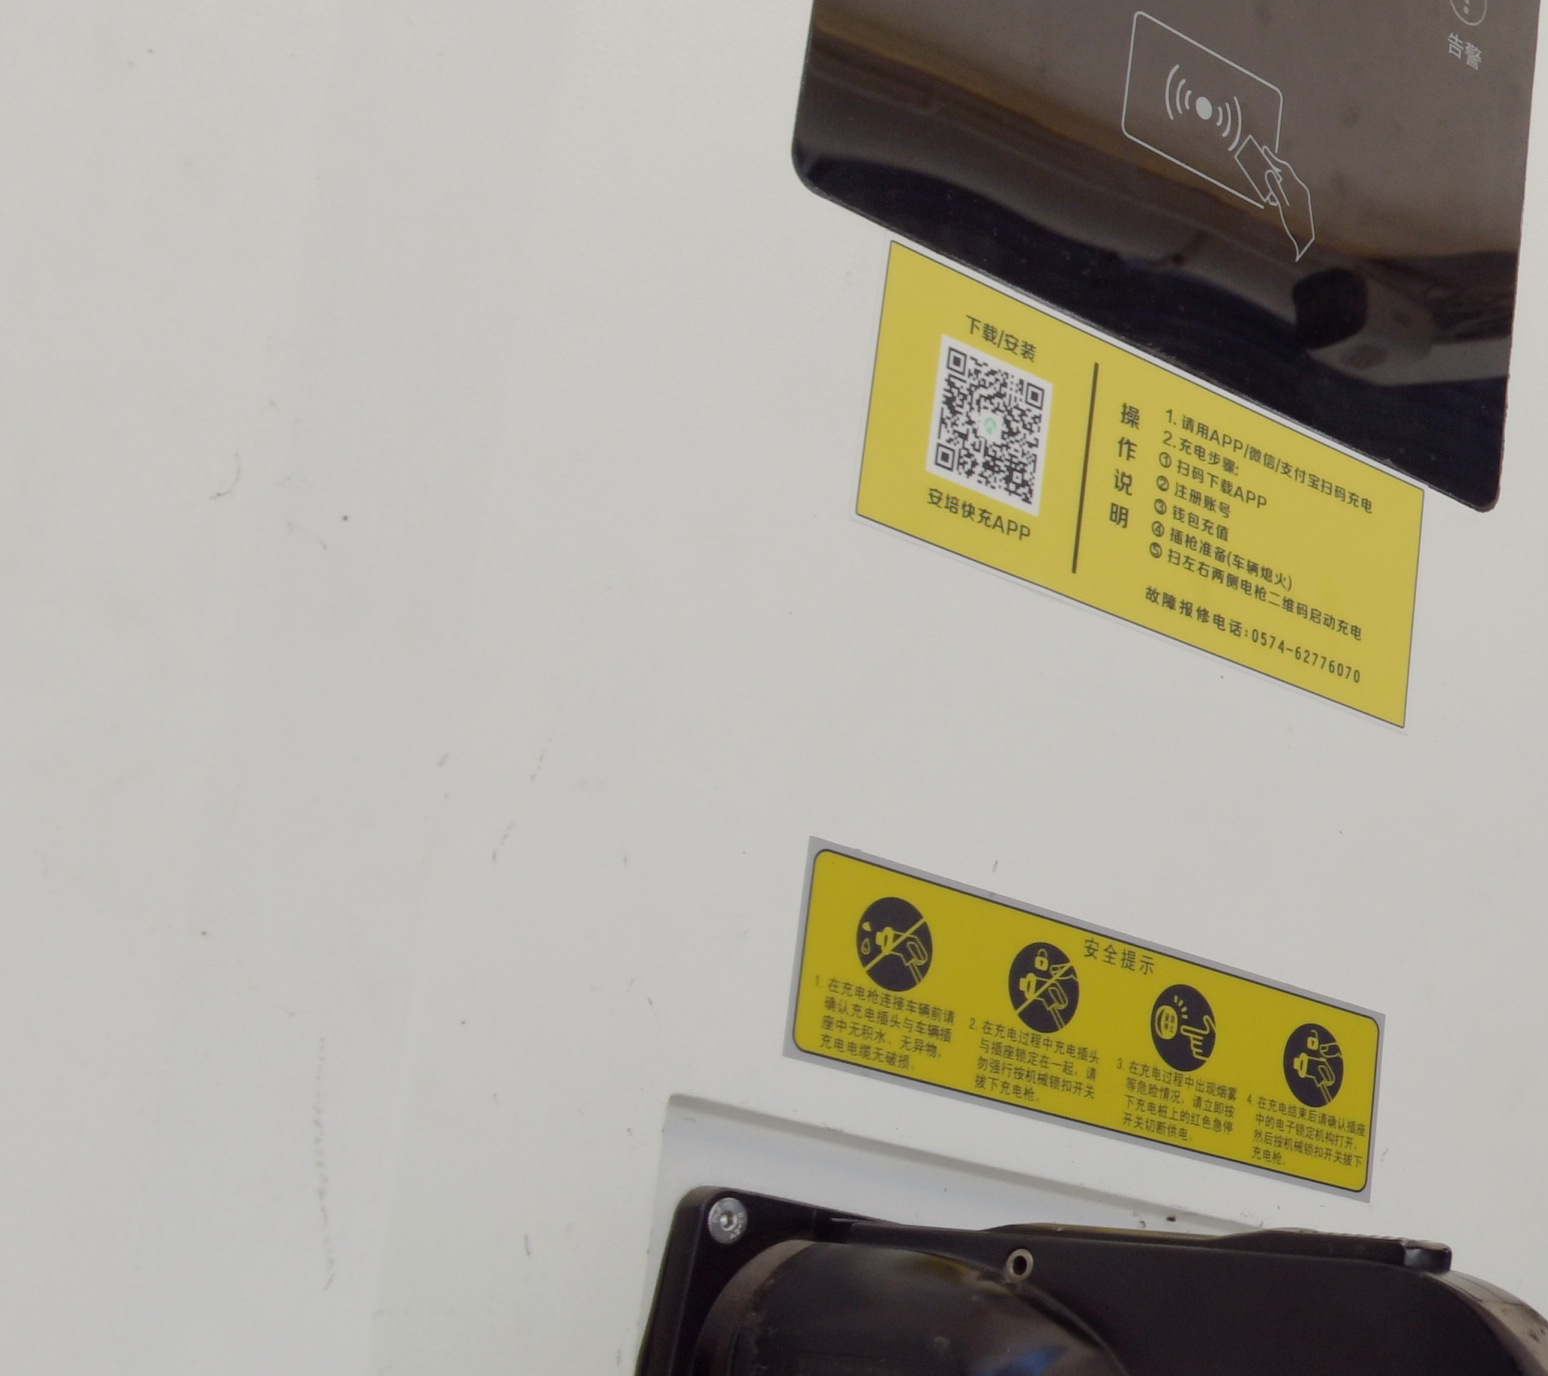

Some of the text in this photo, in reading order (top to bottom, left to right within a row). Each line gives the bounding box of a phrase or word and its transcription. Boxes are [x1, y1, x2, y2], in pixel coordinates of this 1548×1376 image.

[1447, 32, 1482, 71] 告警
[966, 315, 1037, 363] 下载/安装
[1109, 402, 1140, 529] 操作说明
[927, 488, 1031, 541] 安培快充APP
[1084, 938, 1154, 975] 安全提示
